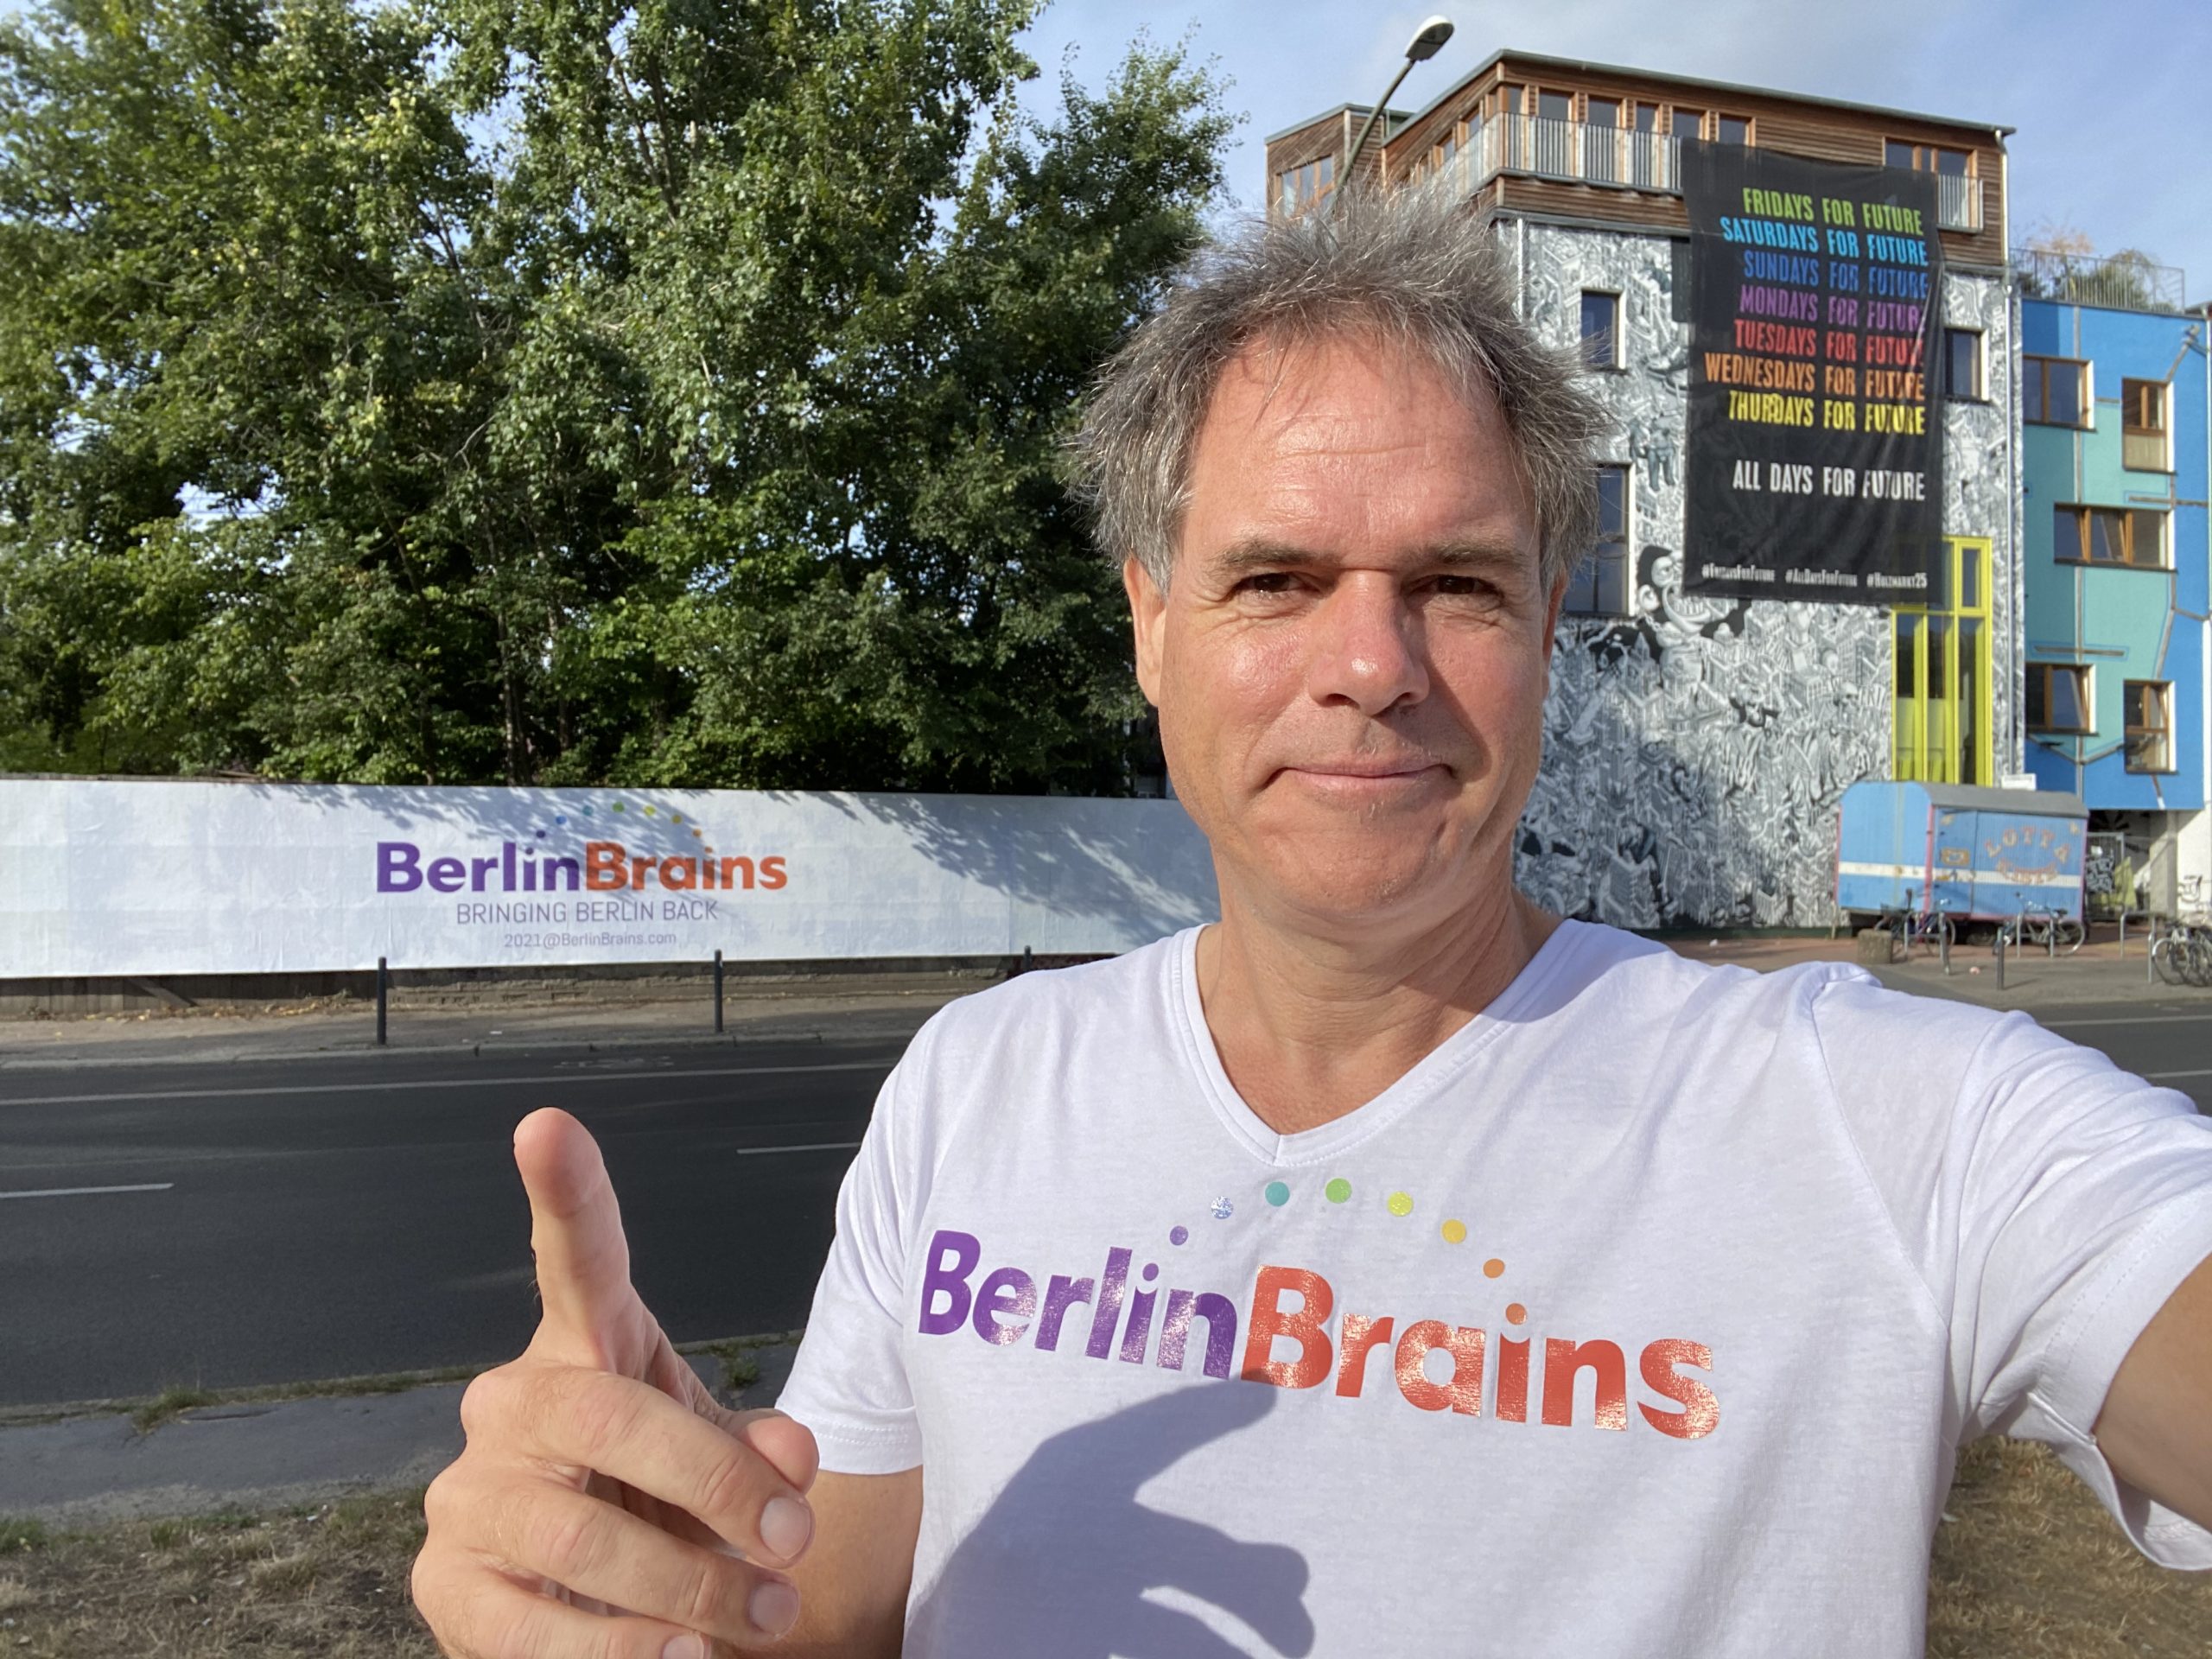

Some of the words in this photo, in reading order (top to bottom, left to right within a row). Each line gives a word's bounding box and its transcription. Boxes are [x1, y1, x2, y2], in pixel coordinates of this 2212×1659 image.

[1743, 188, 1814, 221] FRIDAYS
[1822, 197, 1855, 226] FOR
[1862, 202, 1923, 236] FUTURE
[1719, 217, 1818, 253] SATURDAYS
[1827, 228, 1859, 258] FOR
[1867, 233, 1929, 266] FUTURE
[1744, 250, 1819, 287] SUNDAYS
[1829, 261, 1859, 291] FOR
[1868, 266, 1929, 299] FUTURE
[1739, 284, 1818, 321] MONDAYS
[1827, 296, 1857, 327] FOR
[1734, 319, 1816, 358] TUESDAYS
[1826, 331, 1856, 362] FOR
[1866, 335, 1923, 366] FUTU
[1705, 353, 1815, 392] WEDNESDAYS
[1825, 365, 1856, 397] FOR
[1823, 399, 1855, 430] FOR
[1865, 403, 1925, 435] FUTURE
[1732, 460, 1762, 491] ALL
[1770, 462, 1813, 494] DAYS
[1823, 467, 1855, 497] FOR
[1862, 469, 1925, 501] FUTURE
[377, 841, 788, 893] BerlinBrains
[456, 902, 567, 925] BRINGING
[575, 900, 654, 922] BERLIN
[663, 899, 719, 921] BACK
[504, 931, 677, 950] 2021@BerlinBrains.com
[918, 1229, 1721, 1440] BerlinBrains
